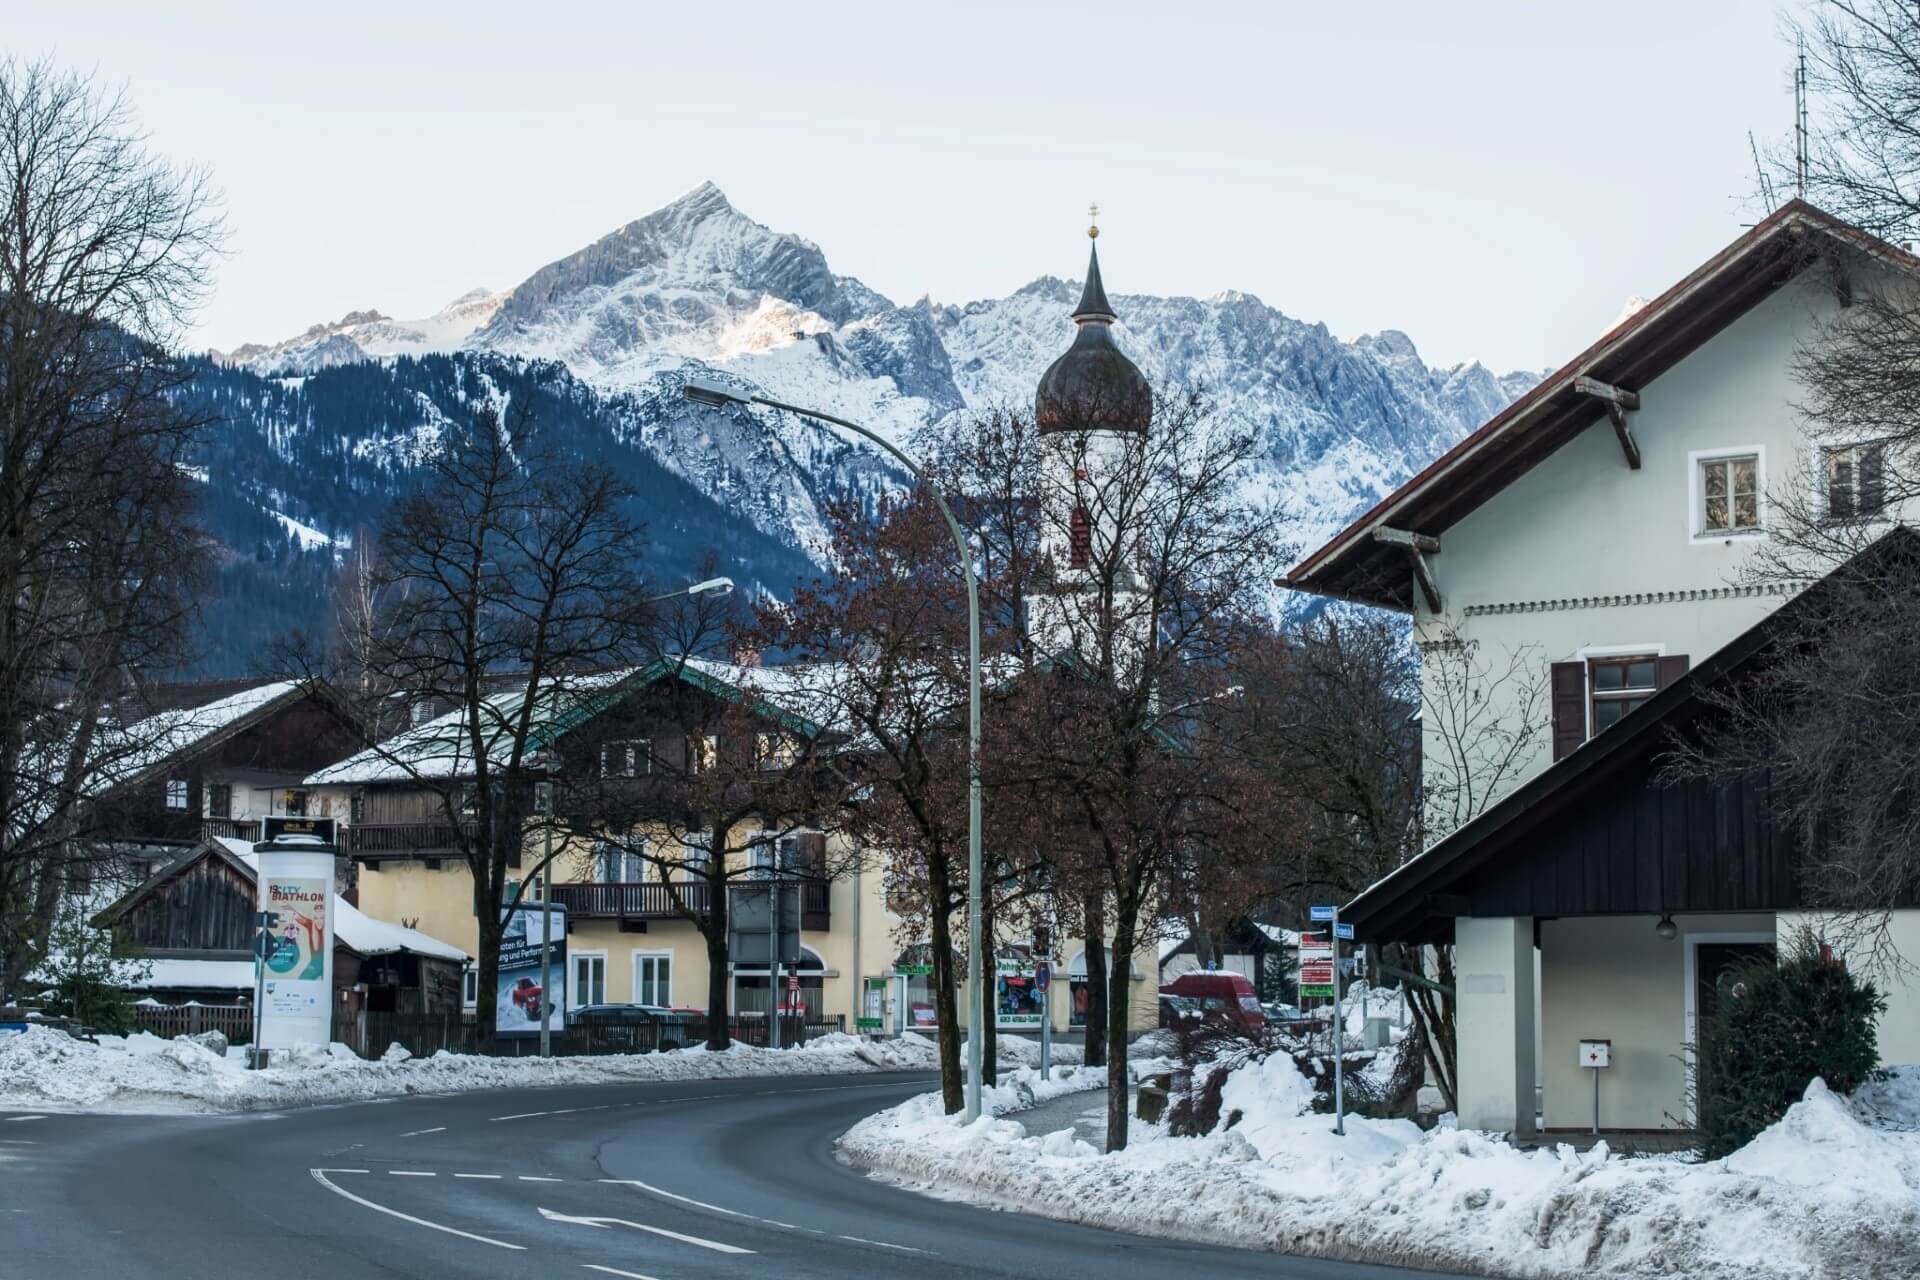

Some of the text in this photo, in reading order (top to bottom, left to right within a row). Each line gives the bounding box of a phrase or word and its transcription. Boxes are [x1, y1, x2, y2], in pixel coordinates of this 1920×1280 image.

[271, 891, 325, 902] BIATHLON
[500, 939, 525, 951] oten für
[509, 951, 521, 960] und
[521, 945, 557, 958] Performce.
